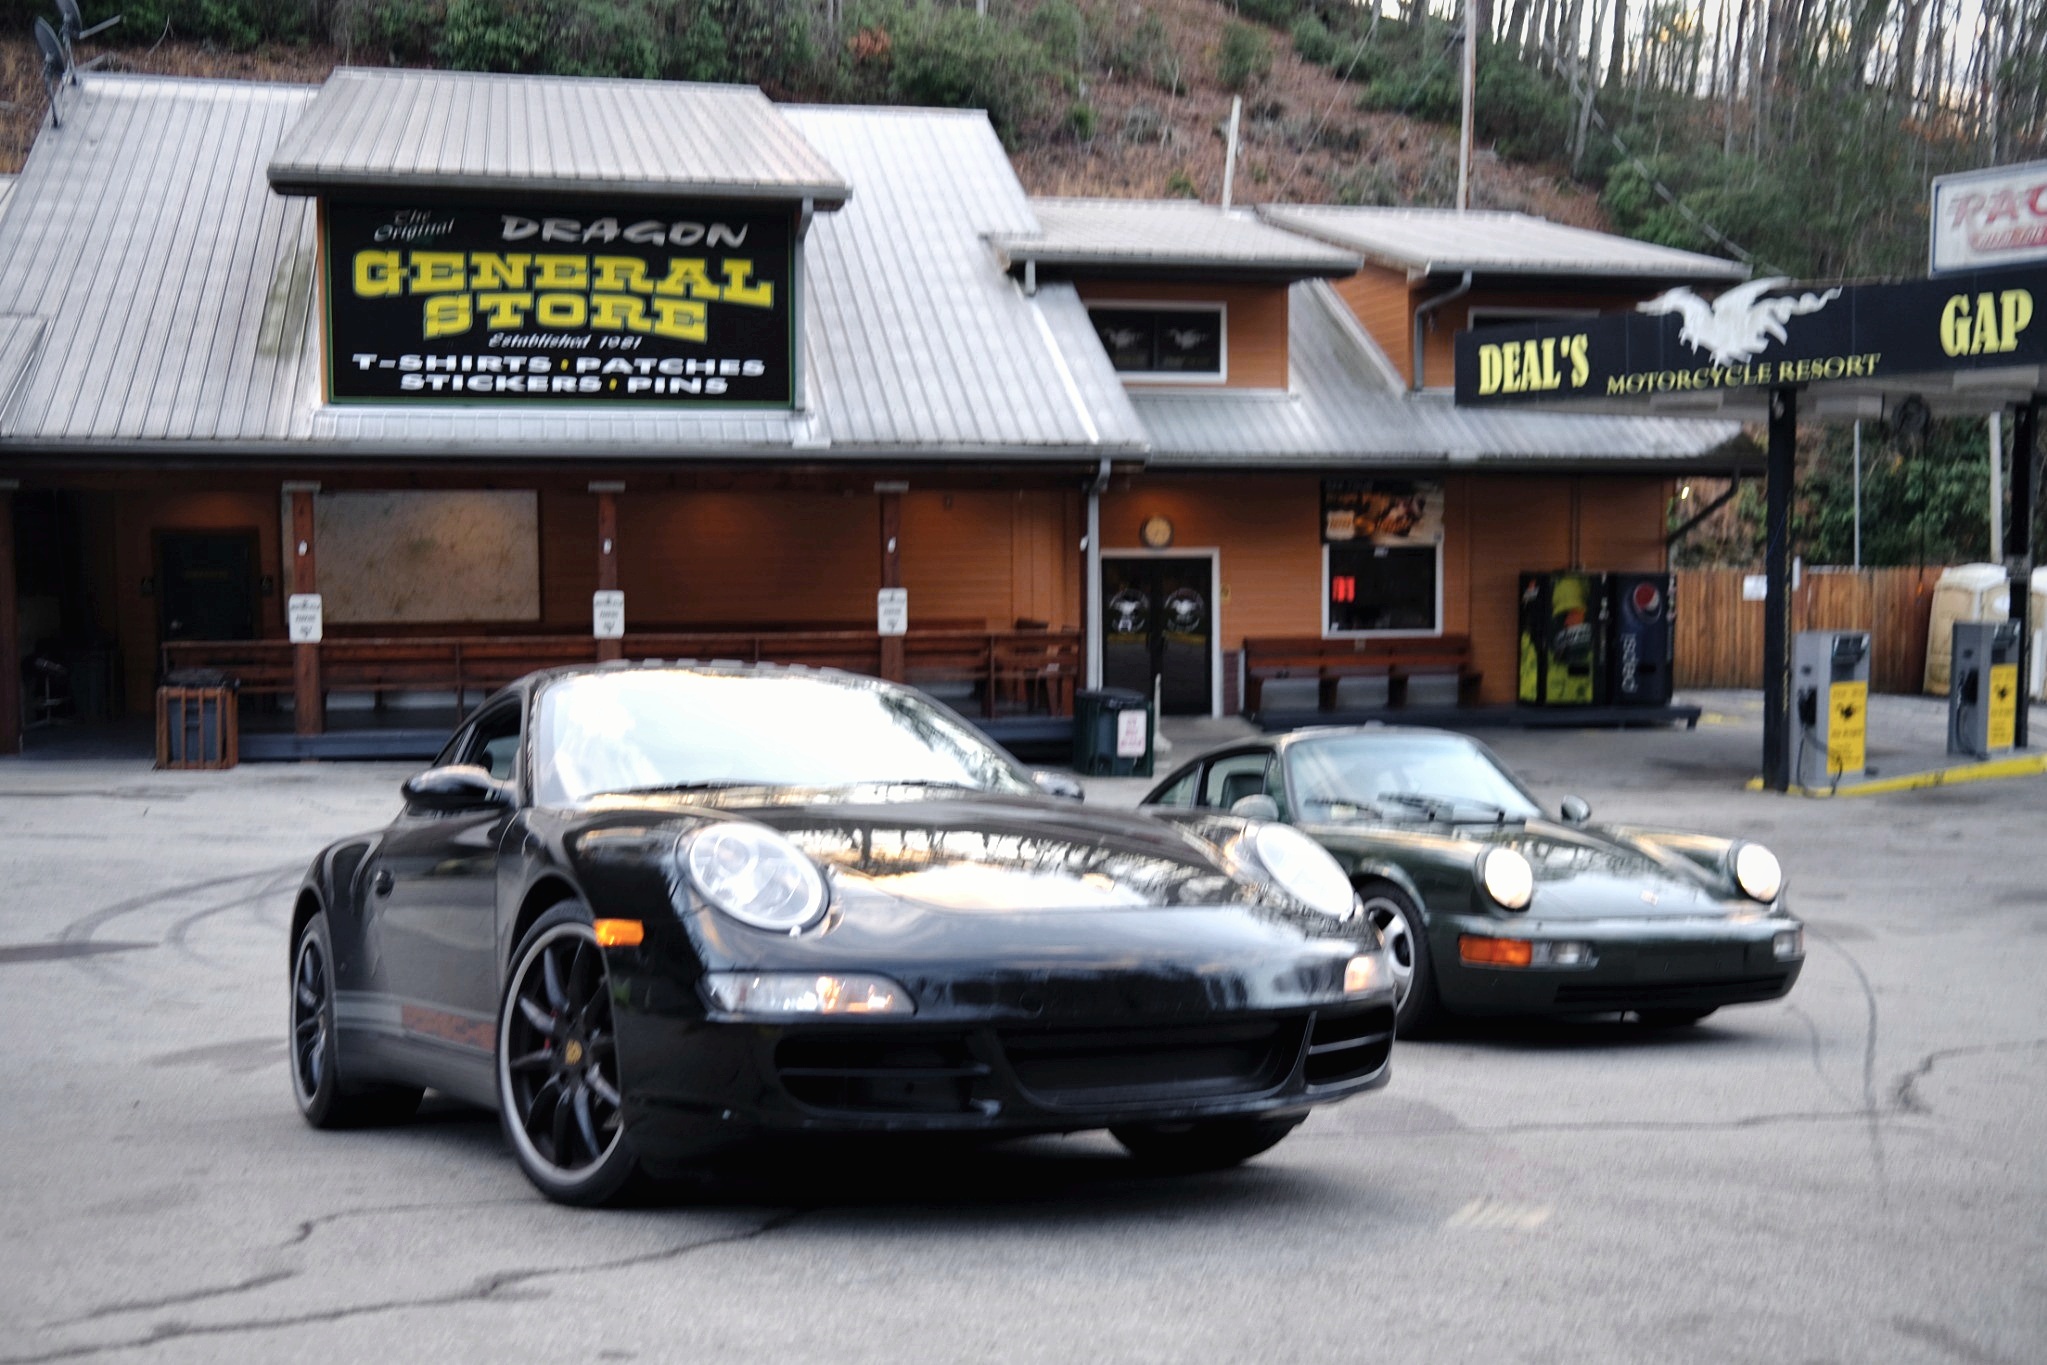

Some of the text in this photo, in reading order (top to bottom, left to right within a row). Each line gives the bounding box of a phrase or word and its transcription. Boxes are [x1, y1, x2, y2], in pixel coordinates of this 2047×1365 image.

[373, 218, 456, 242] Original
[394, 209, 432, 225] The
[501, 214, 749, 248] DRAGON
[353, 249, 775, 309] GENERAL
[423, 292, 708, 344] STORE
[1939, 287, 2034, 358] GAP
[488, 332, 592, 349] Established
[352, 353, 766, 377] T-SHIRTS PATCHES
[1478, 333, 1591, 396] DEAL'S
[1605, 352, 1882, 396] MOTORCYCLE RESORT
[400, 374, 729, 395] STICKERS PINS
